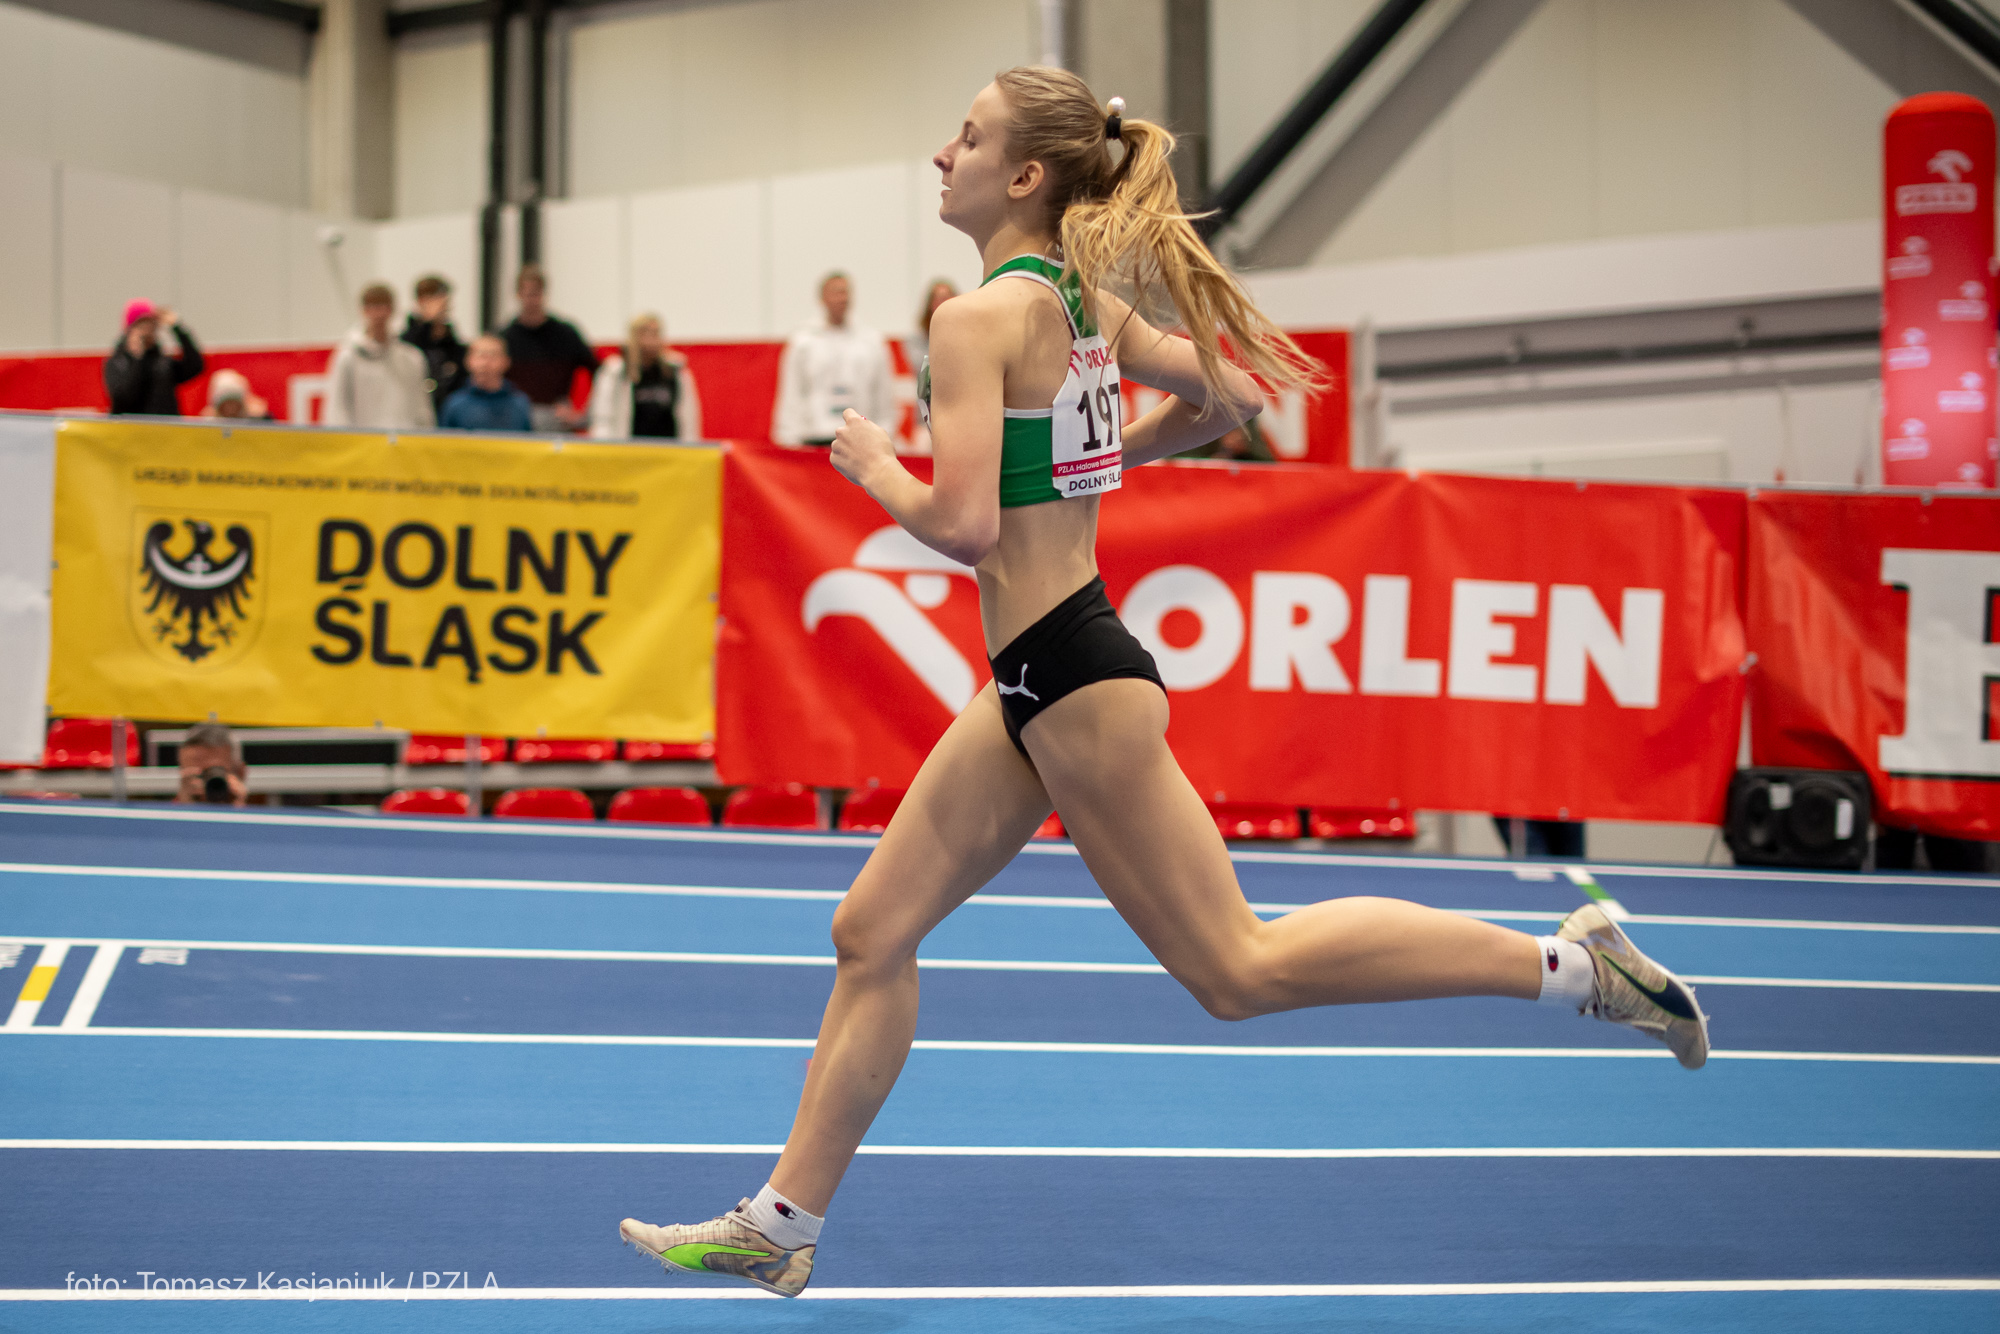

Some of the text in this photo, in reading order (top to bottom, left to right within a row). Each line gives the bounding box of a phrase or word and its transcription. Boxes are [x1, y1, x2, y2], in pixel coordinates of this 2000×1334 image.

[1077, 382, 1122, 452] 197
[1057, 464, 1075, 475] PZLA
[1075, 461, 1100, 472] Halowe
[1068, 474, 1108, 492] DOLNY
[315, 518, 633, 597] DOLNY
[310, 583, 606, 685] ŚLĄSK
[1119, 563, 1665, 710] ORLEN
